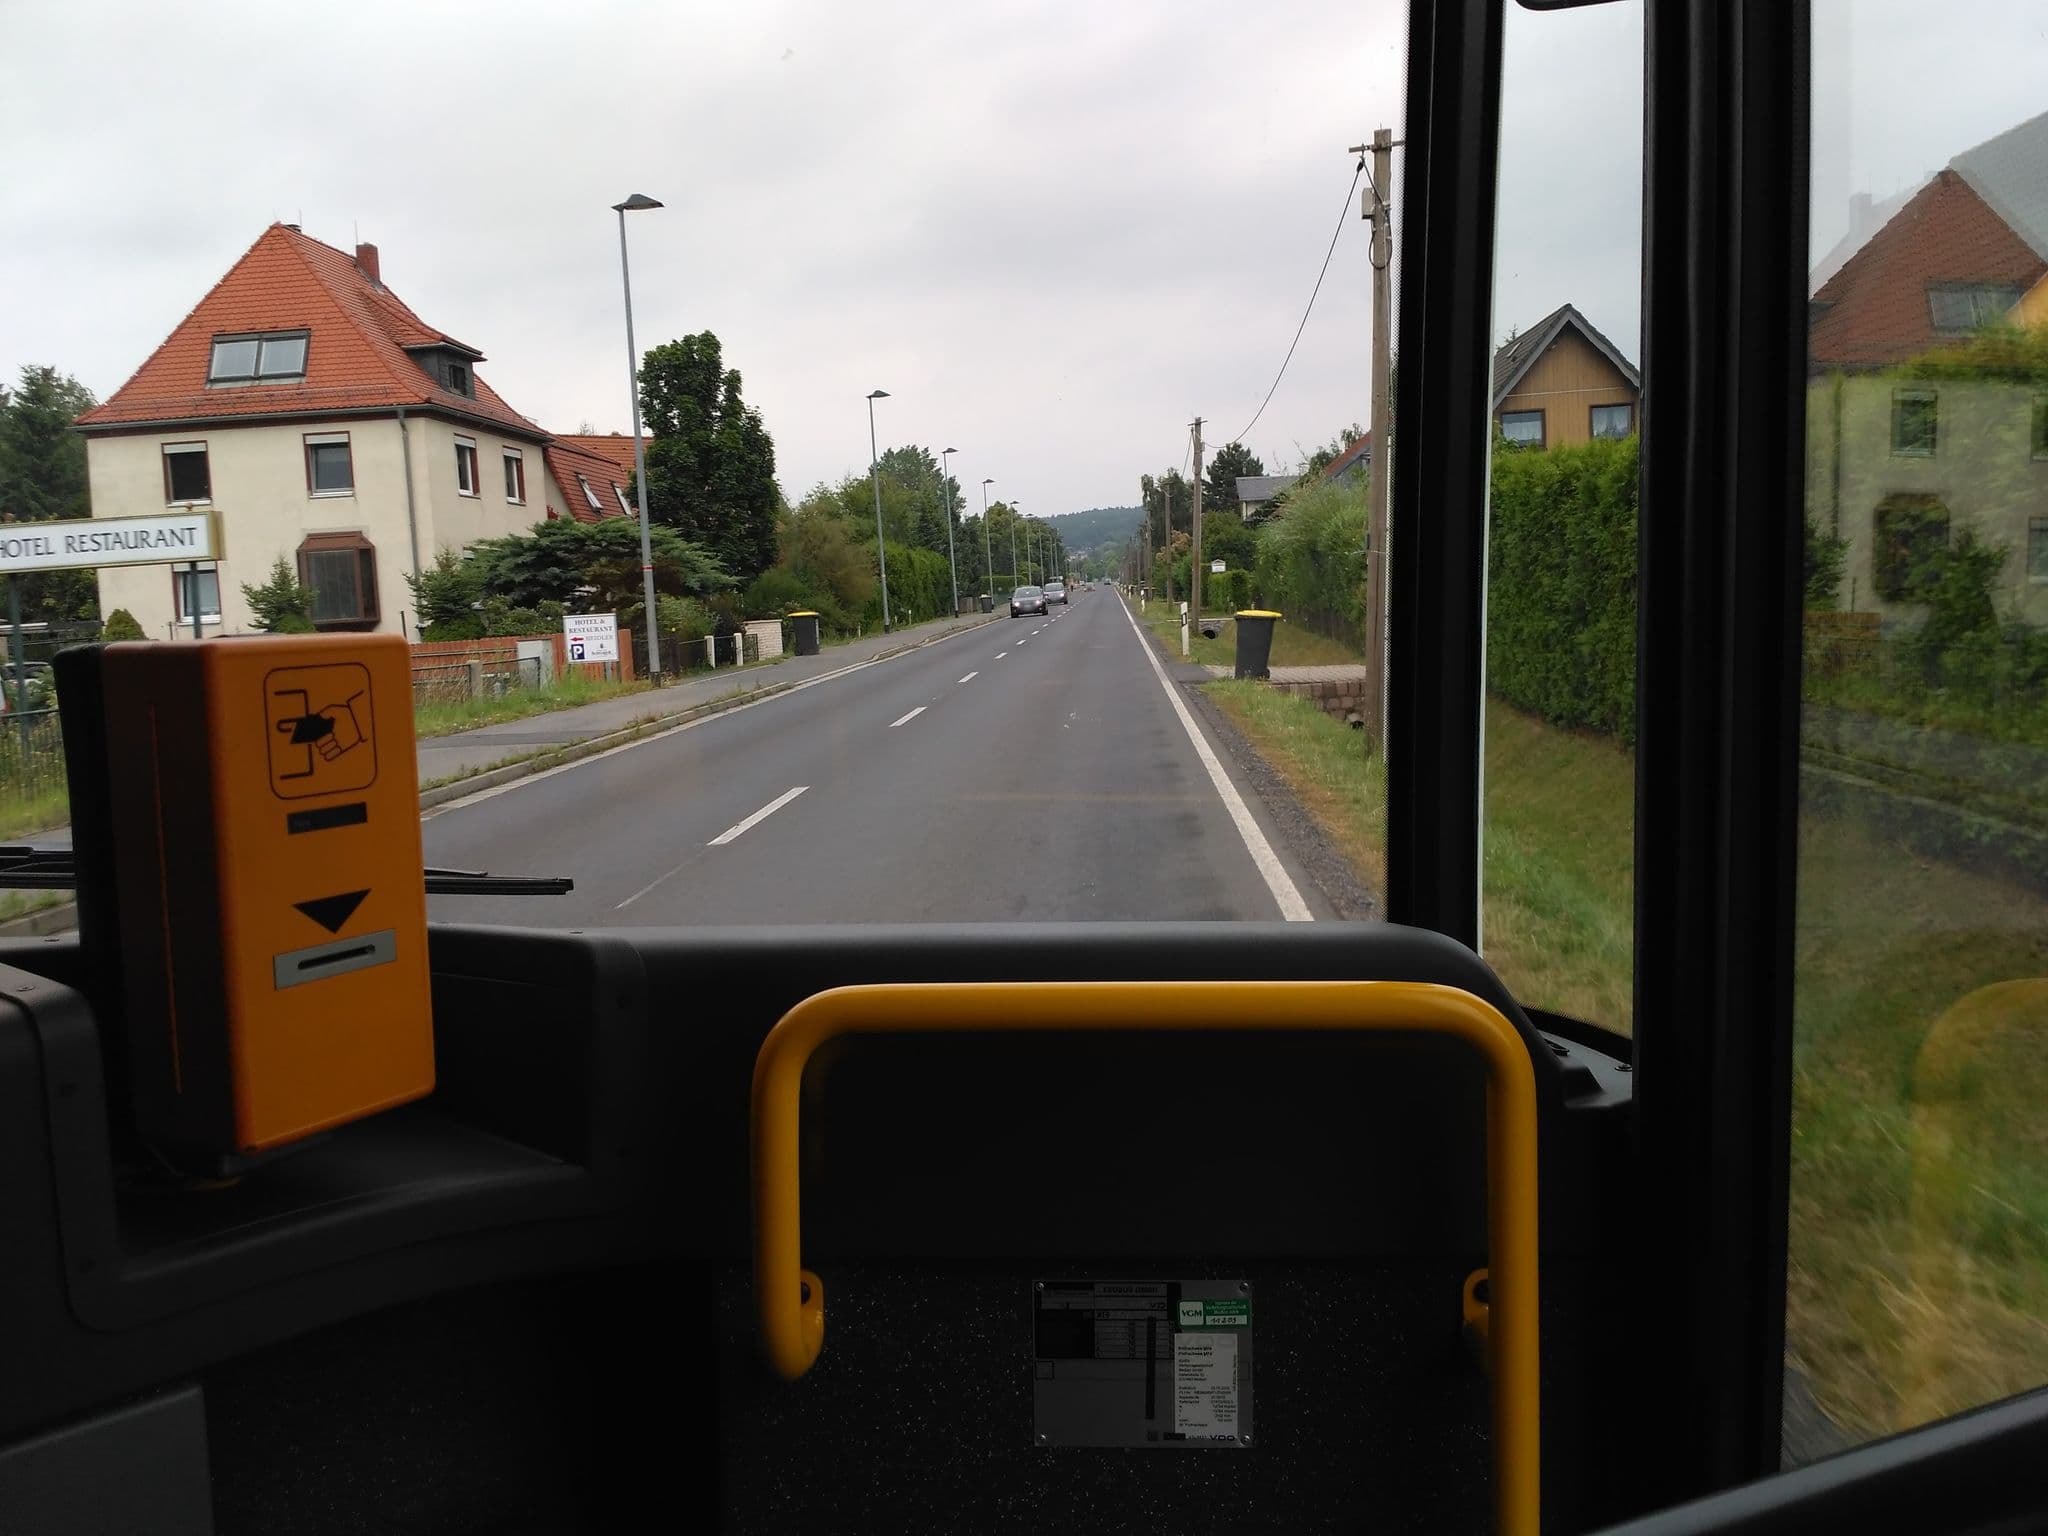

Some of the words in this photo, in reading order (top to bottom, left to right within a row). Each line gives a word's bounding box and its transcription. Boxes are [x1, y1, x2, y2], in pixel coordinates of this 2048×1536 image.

[66, 527, 197, 554] RESTAURANT
[573, 645, 583, 659] P
[1182, 1309, 1203, 1318] VGM
